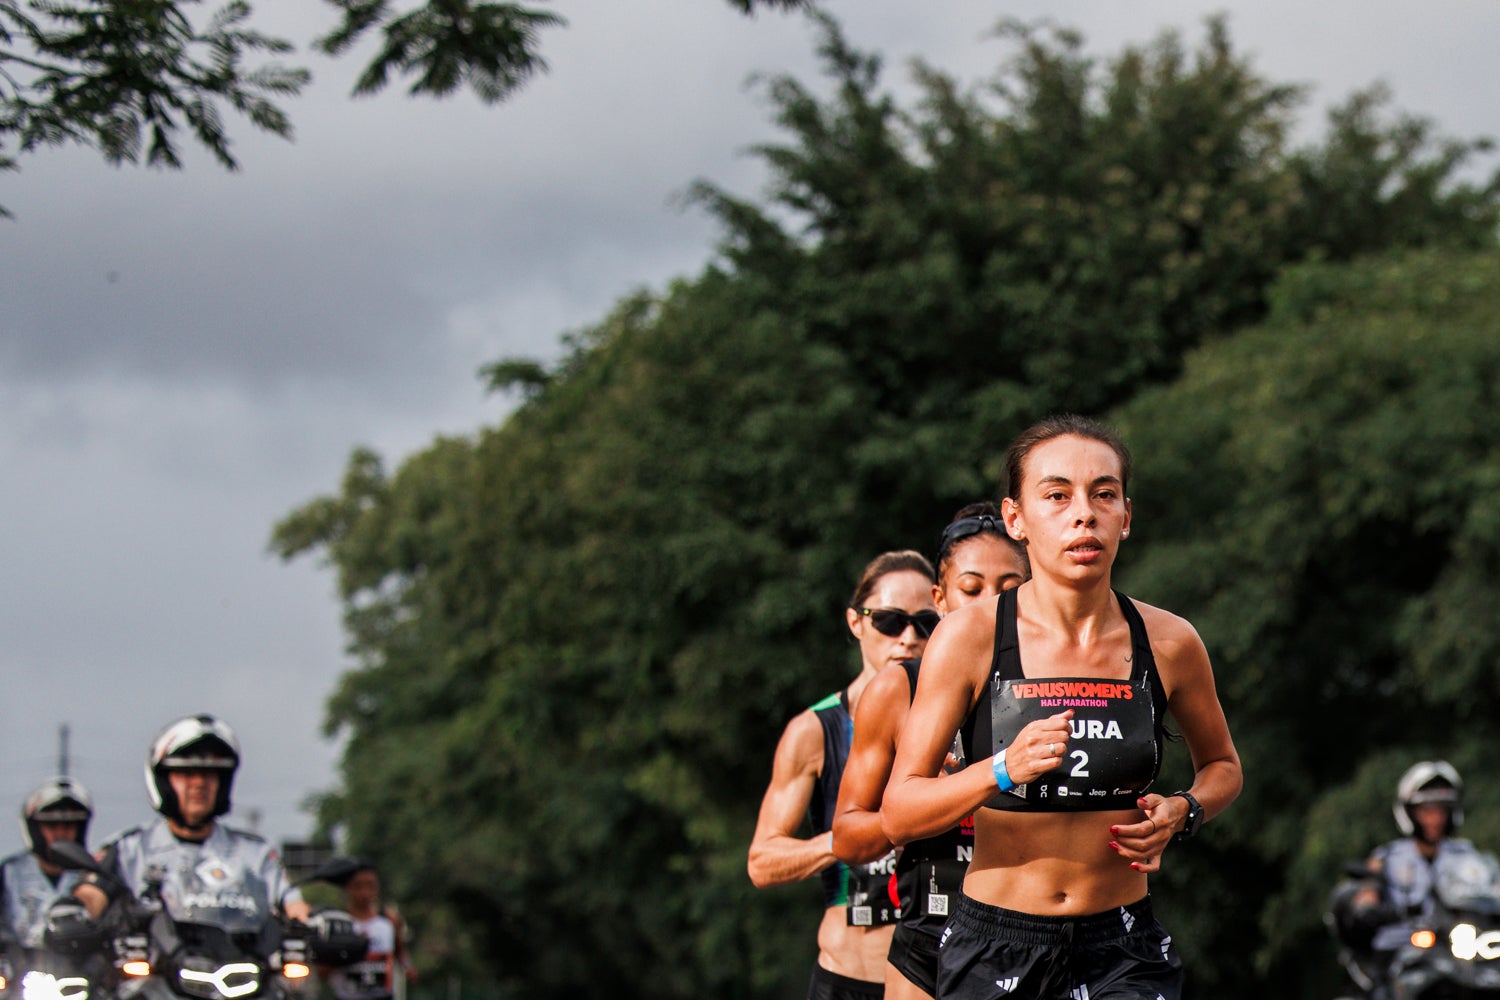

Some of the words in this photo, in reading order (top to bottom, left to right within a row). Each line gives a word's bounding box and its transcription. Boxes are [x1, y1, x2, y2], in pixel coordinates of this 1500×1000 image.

[1040, 699, 1062, 707] HALF
[1063, 699, 1108, 707] MARATHON
[1070, 750, 1089, 777] 2
[1089, 789, 1107, 797] Jeep
